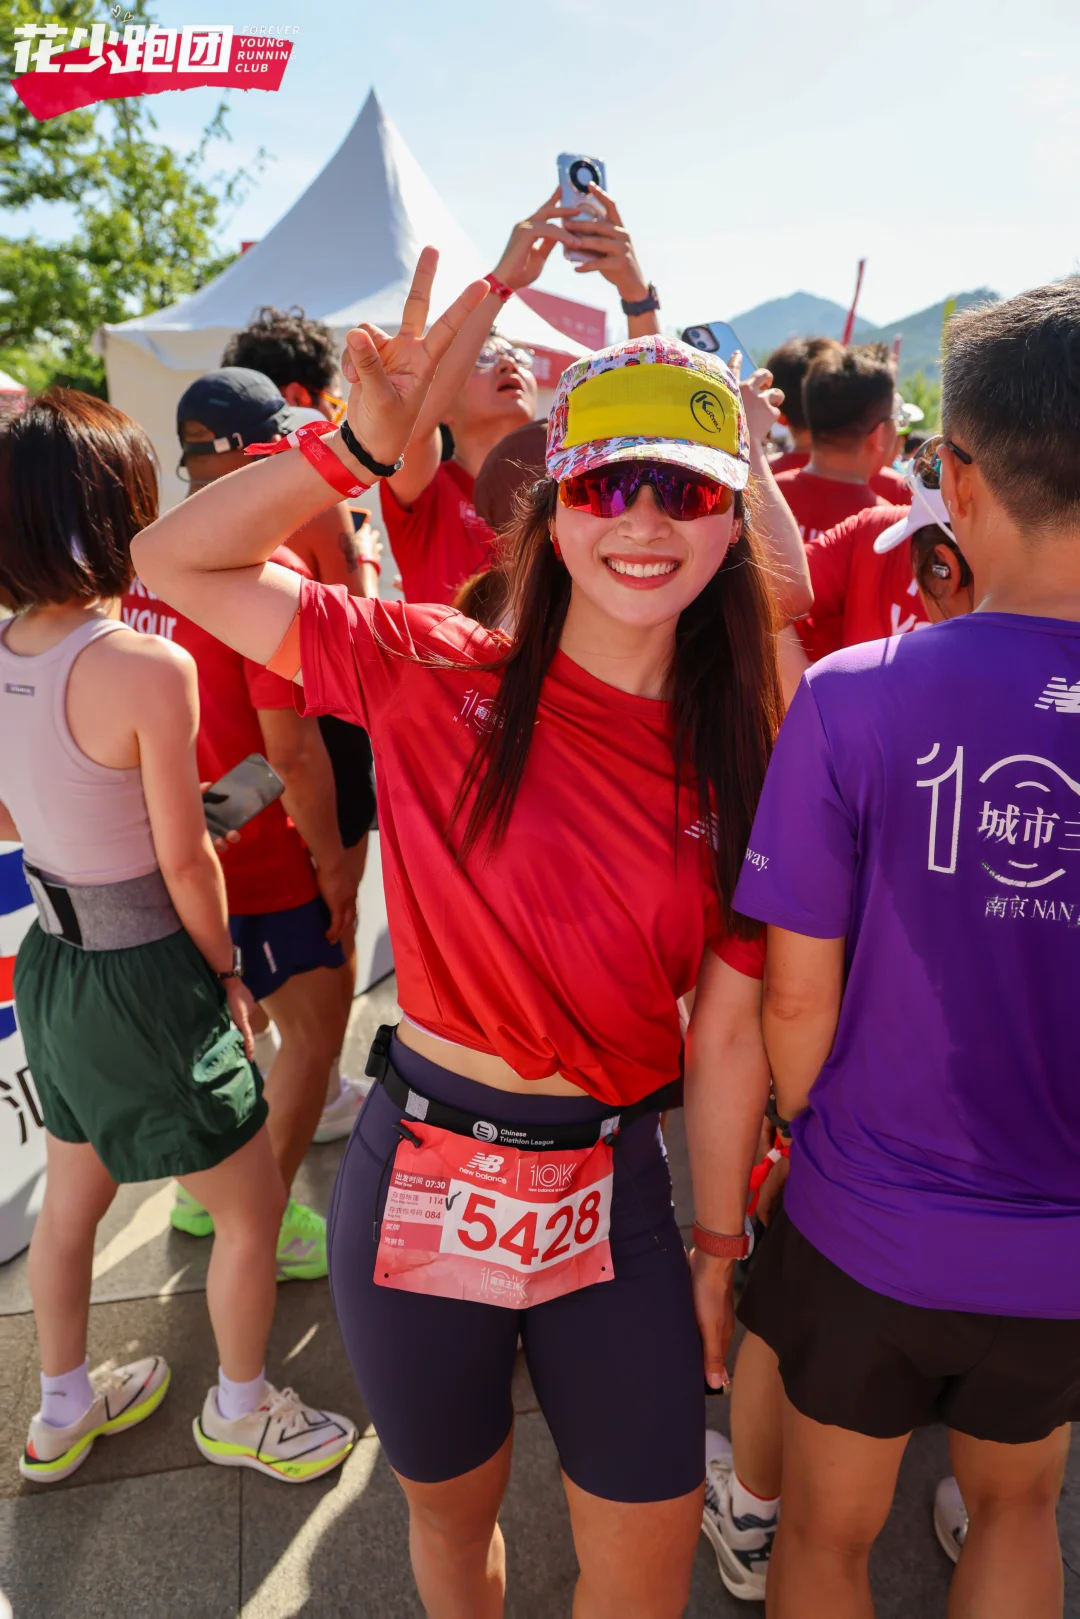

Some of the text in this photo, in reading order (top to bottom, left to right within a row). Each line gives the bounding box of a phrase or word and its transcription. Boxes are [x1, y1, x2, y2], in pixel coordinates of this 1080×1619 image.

[984, 895, 1080, 927] 南京 NAN
[500, 1129, 527, 1137] Chinese
[500, 1136, 554, 1147] Triathlon League
[459, 1167, 508, 1185] new balance
[530, 1163, 577, 1187] 10K
[425, 1180, 446, 1189] 07:30
[428, 1196, 444, 1205] 114
[425, 1210, 441, 1220] 084
[457, 1190, 601, 1266] 5428
